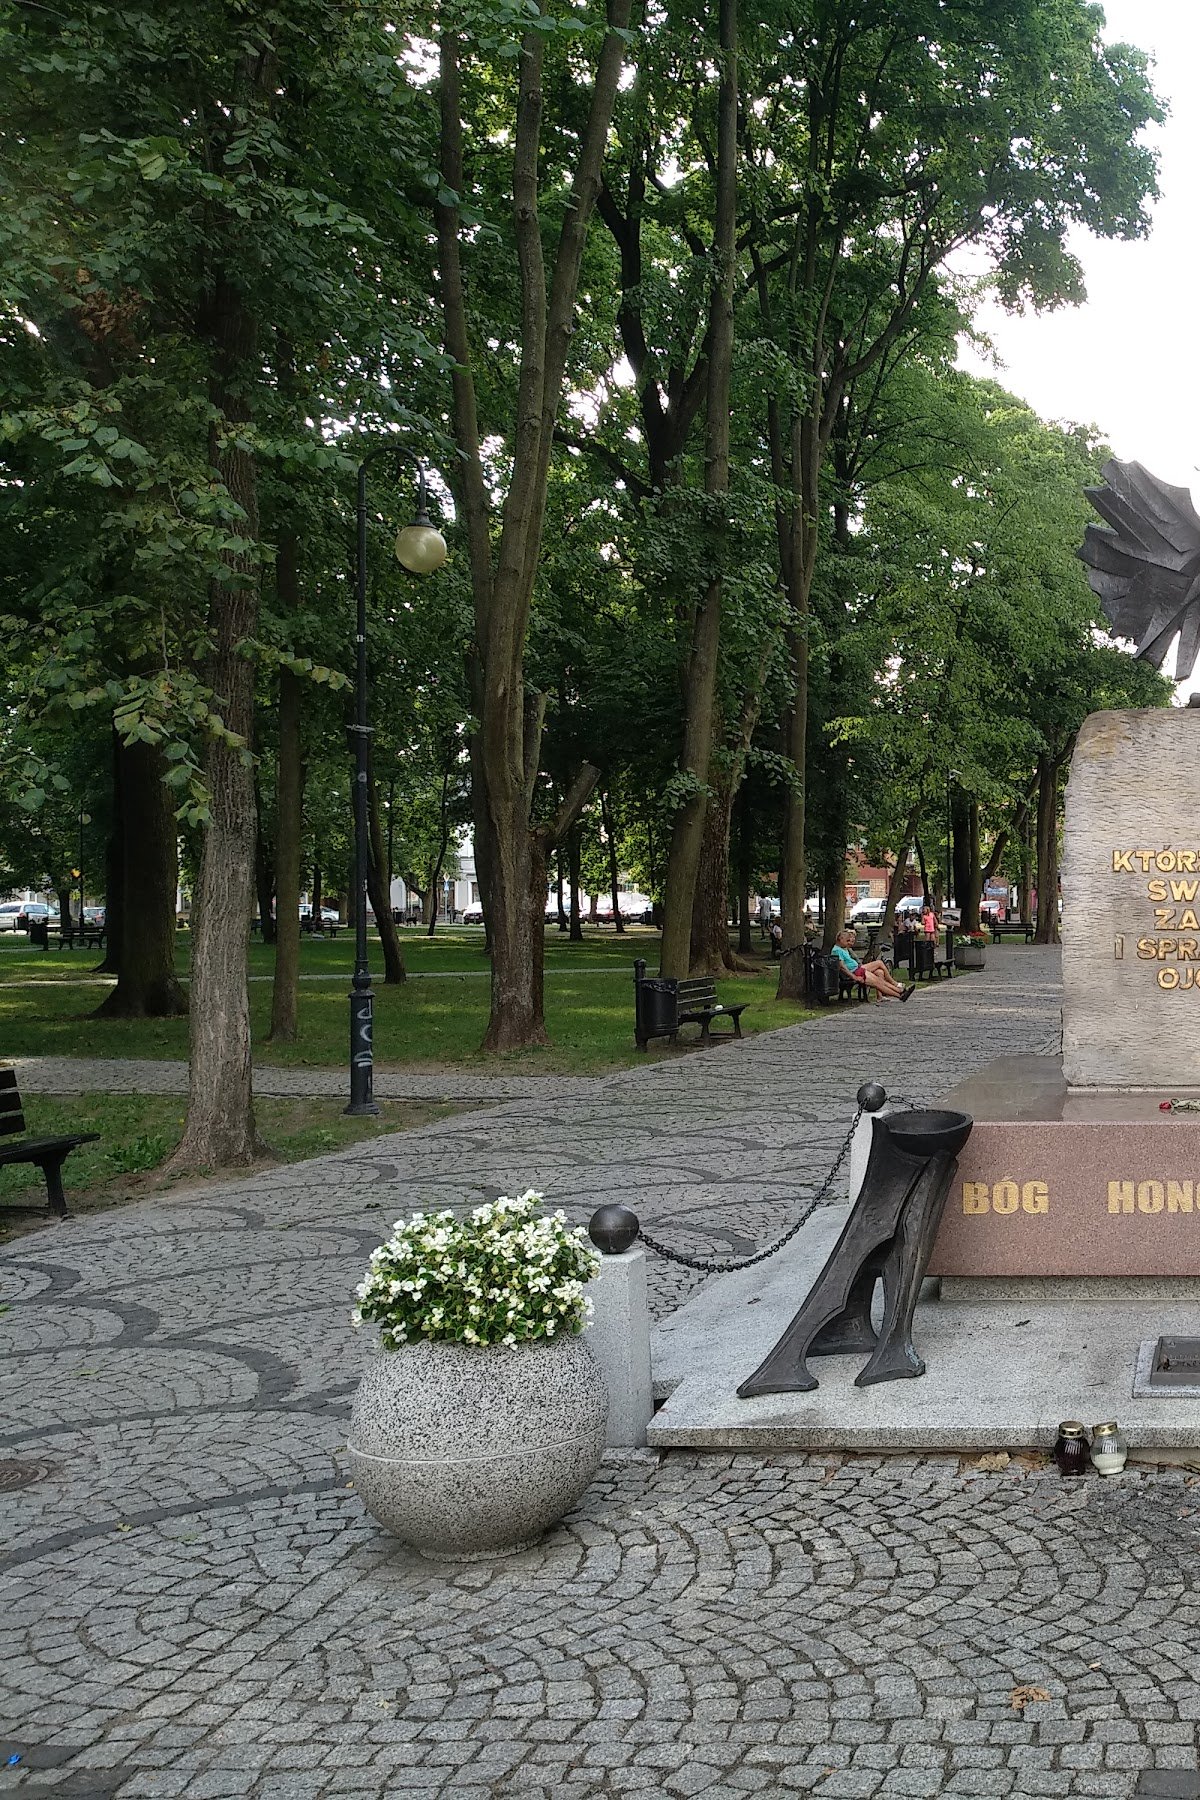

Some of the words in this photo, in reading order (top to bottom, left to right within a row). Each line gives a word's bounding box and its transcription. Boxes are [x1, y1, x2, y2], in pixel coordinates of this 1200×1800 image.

[1154, 908, 1200, 931] ZA
[1114, 934, 1125, 960] I
[962, 1176, 1050, 1215] BÓG
